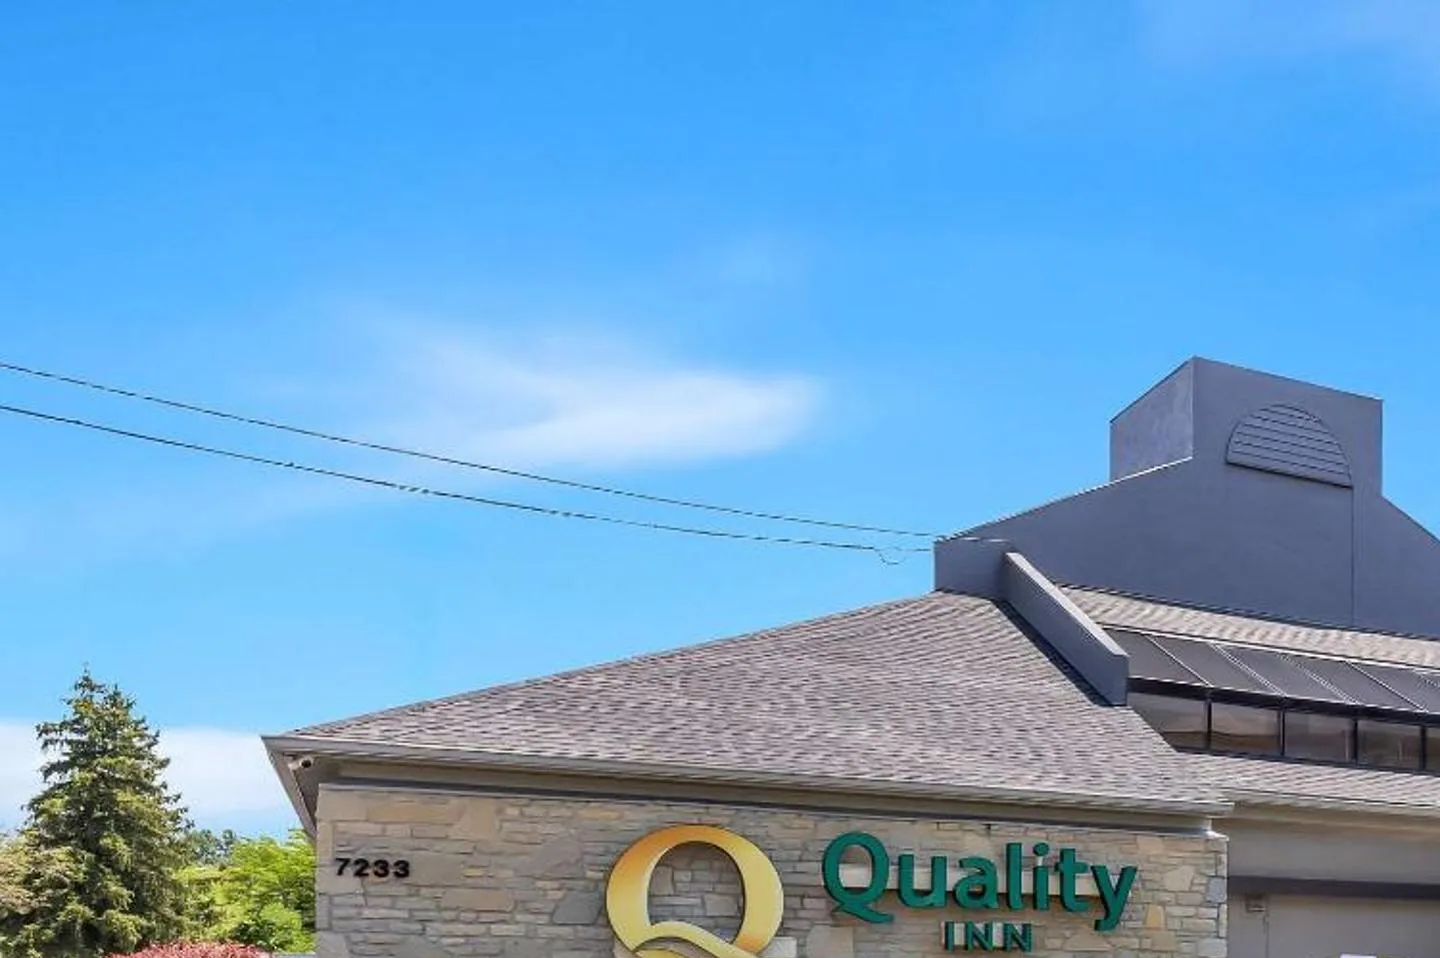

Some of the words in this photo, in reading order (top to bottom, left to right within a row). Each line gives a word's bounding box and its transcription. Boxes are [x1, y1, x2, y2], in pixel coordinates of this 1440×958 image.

[335, 857, 410, 878] 7233
[822, 831, 1137, 931] Quality
[943, 920, 1032, 951] INN
